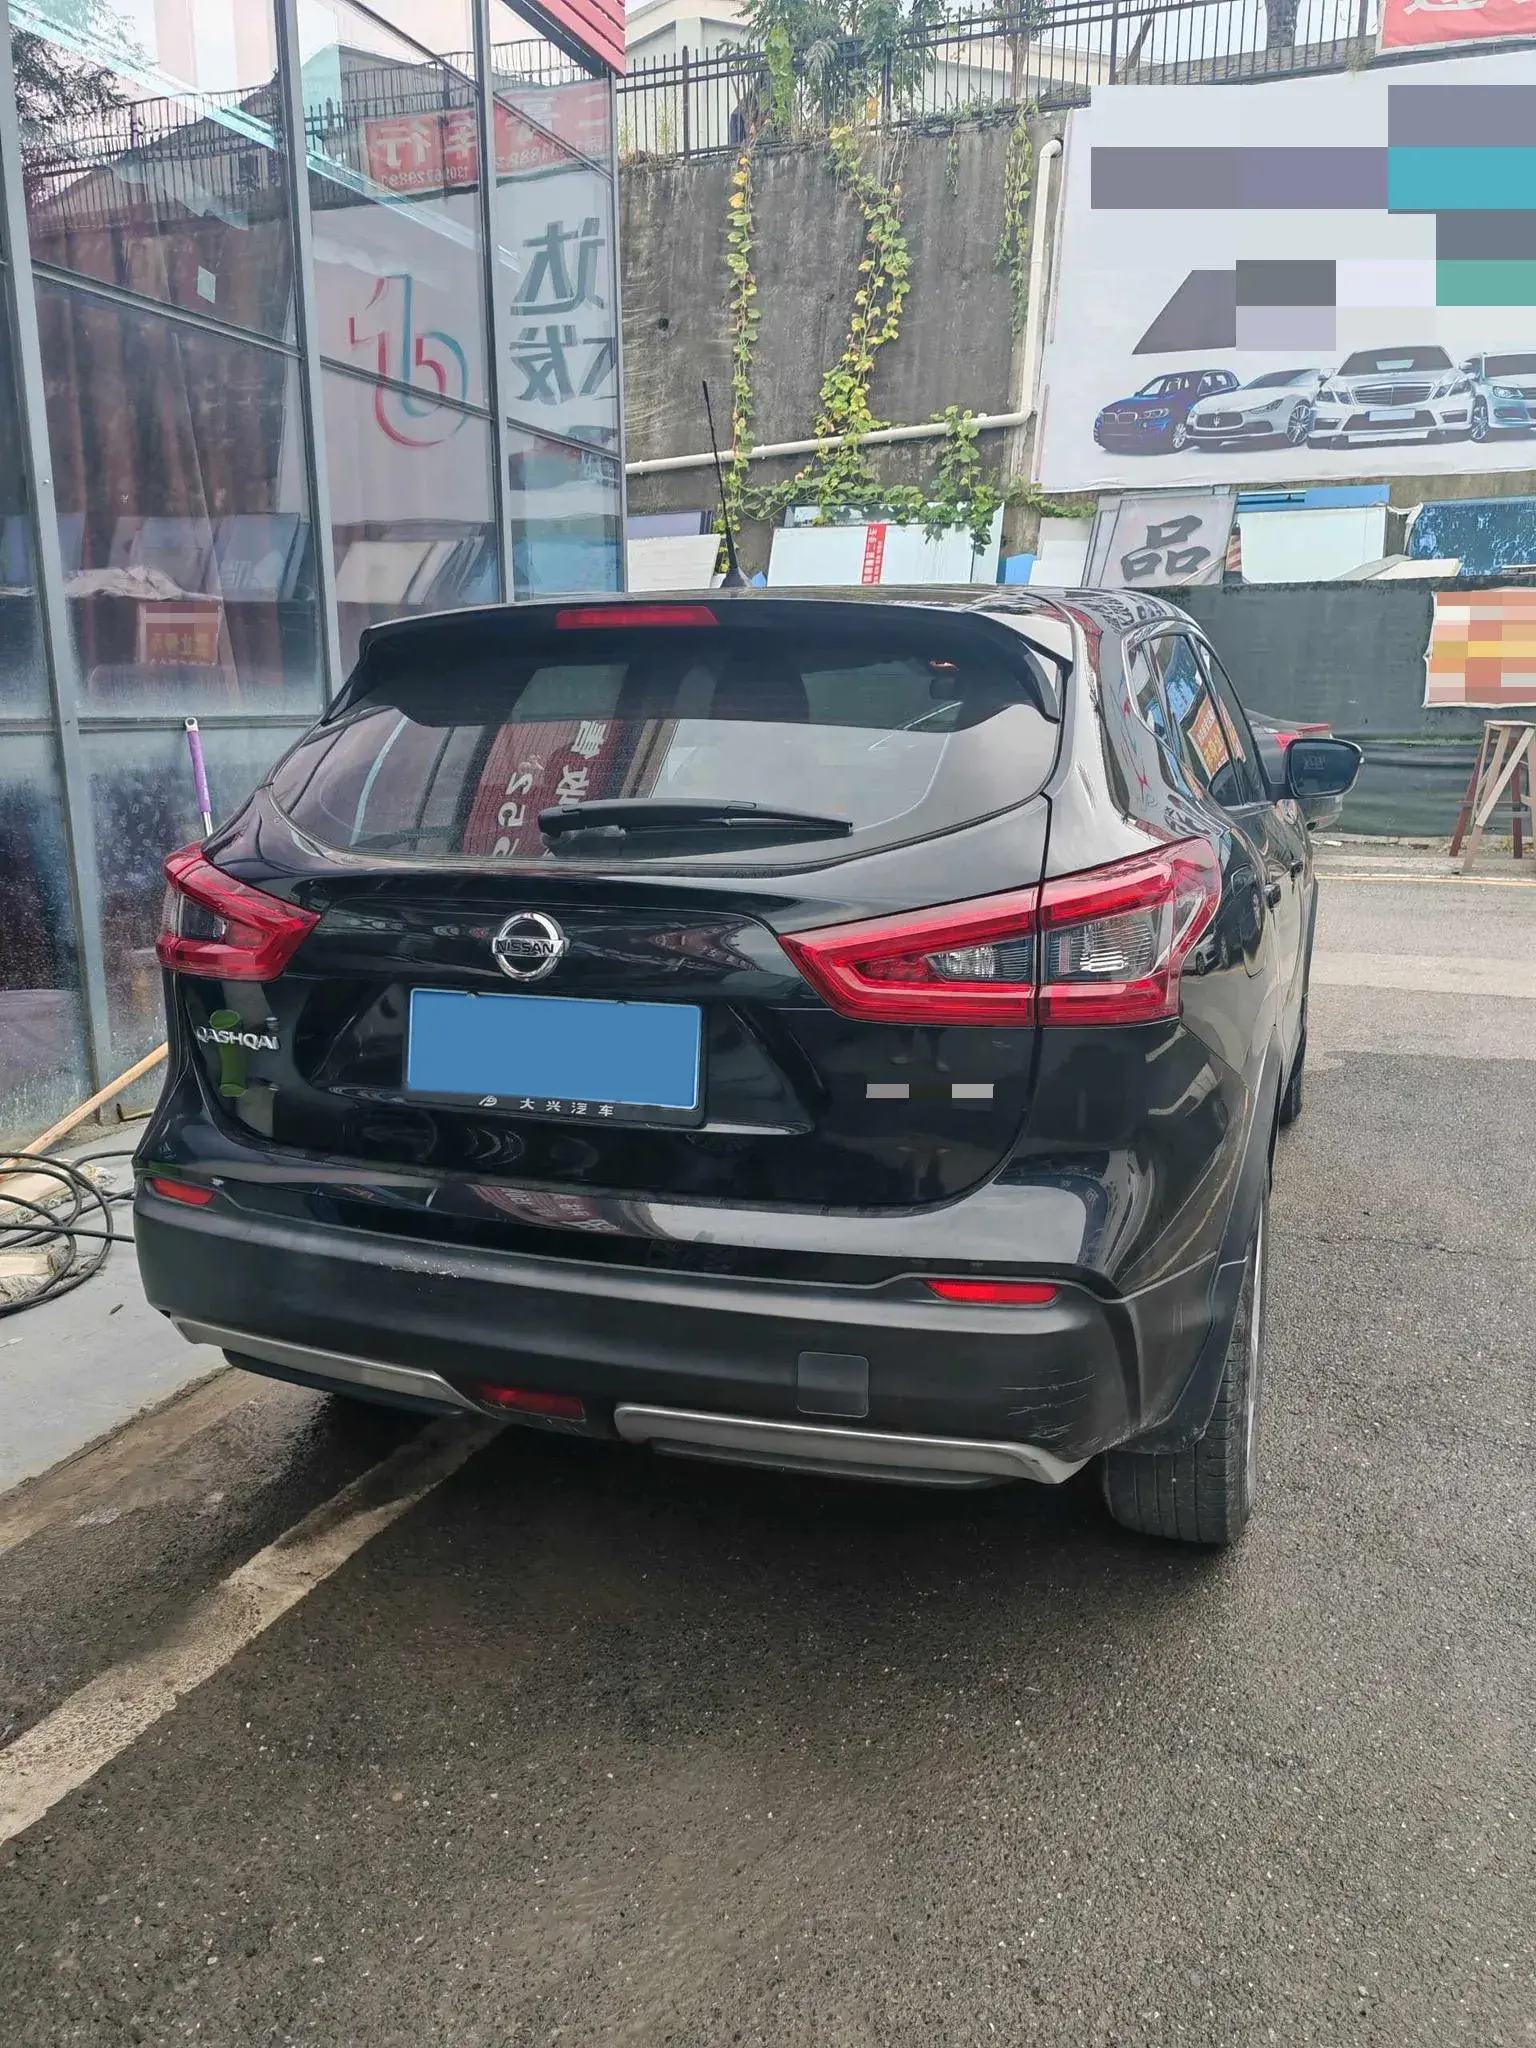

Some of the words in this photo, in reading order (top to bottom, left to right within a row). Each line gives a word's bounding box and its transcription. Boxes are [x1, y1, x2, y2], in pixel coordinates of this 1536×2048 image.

[1121, 515, 1211, 582] 品
[496, 939, 555, 956] NISSAN
[196, 1026, 280, 1051] QASHQAI
[519, 1097, 614, 1117] 大兴汽车
